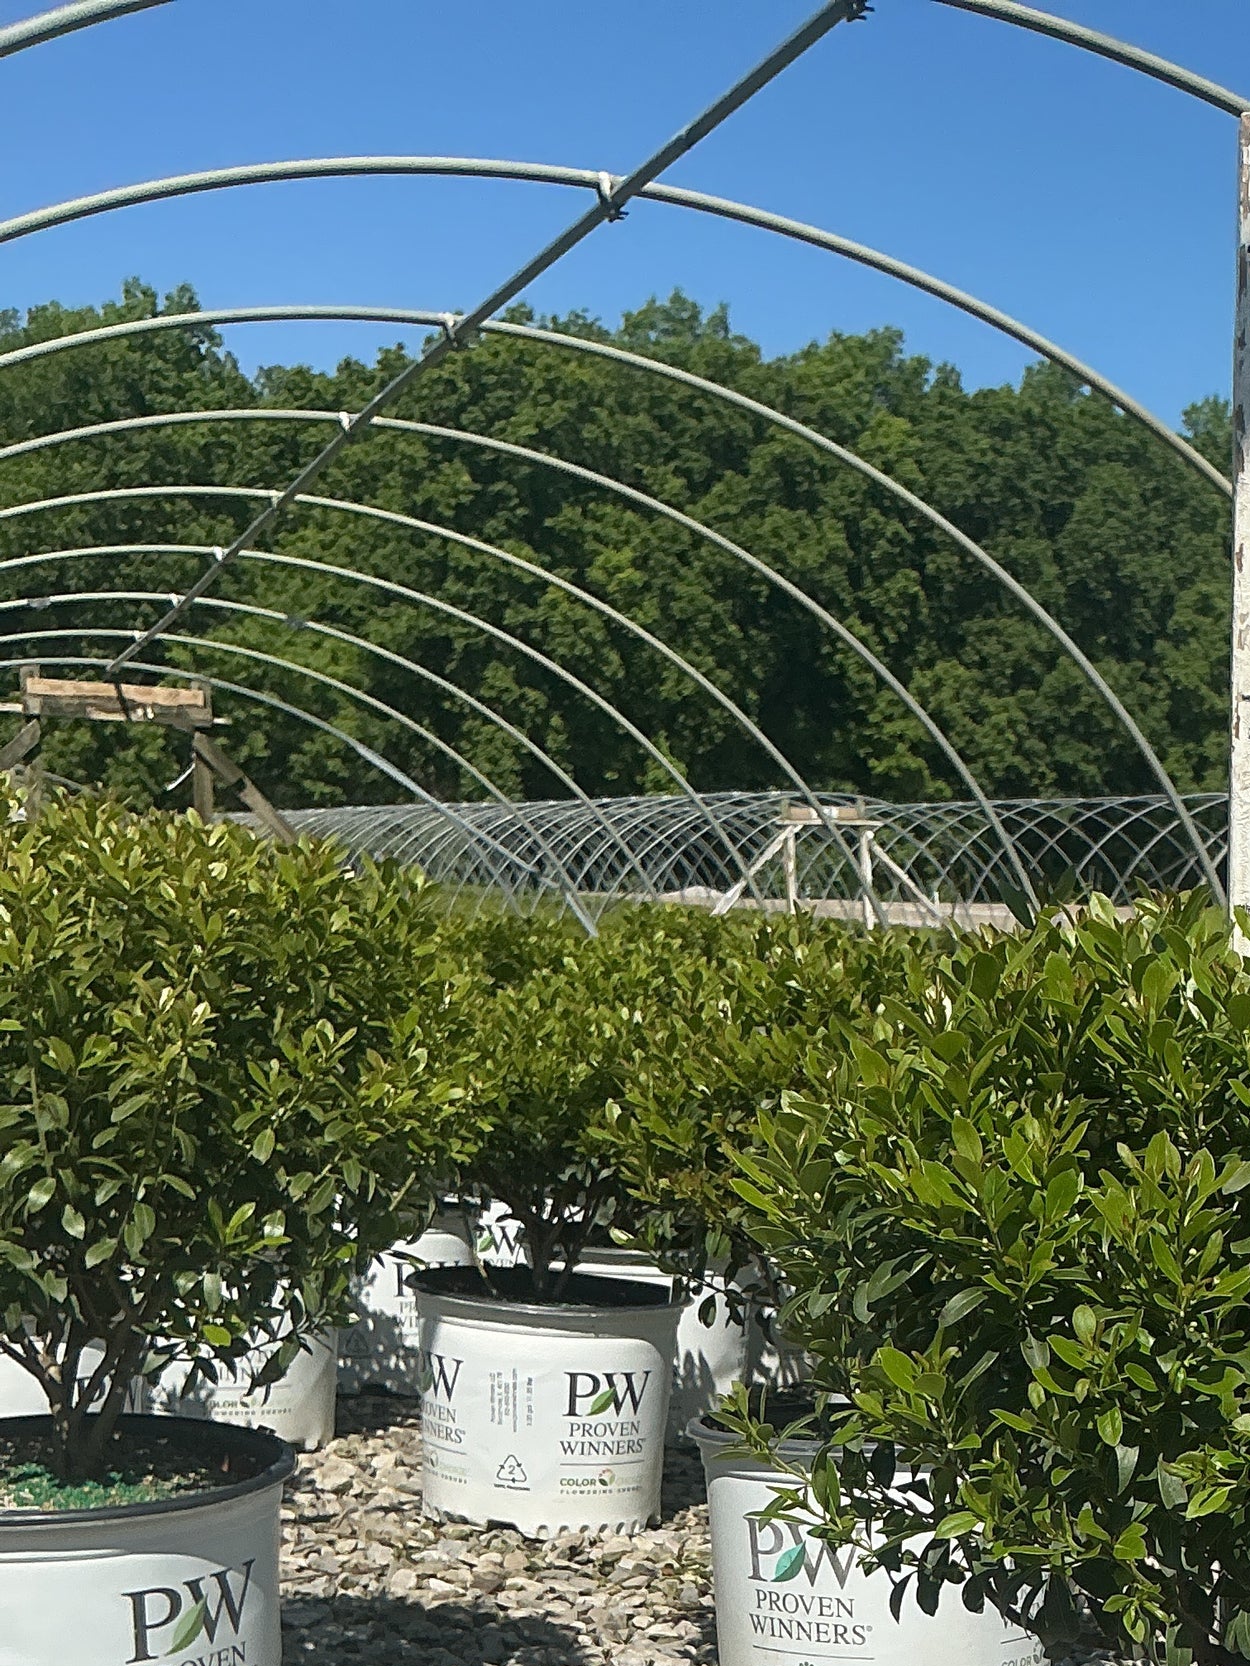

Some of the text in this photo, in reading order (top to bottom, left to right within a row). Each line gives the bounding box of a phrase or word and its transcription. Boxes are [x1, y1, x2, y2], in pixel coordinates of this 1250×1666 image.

[562, 1370, 652, 1418] PW
[569, 1421, 641, 1438] PROVEN
[560, 1478, 597, 1487] COLOR
[121, 1558, 256, 1665] PW
[755, 1588, 855, 1618] PROVEN
